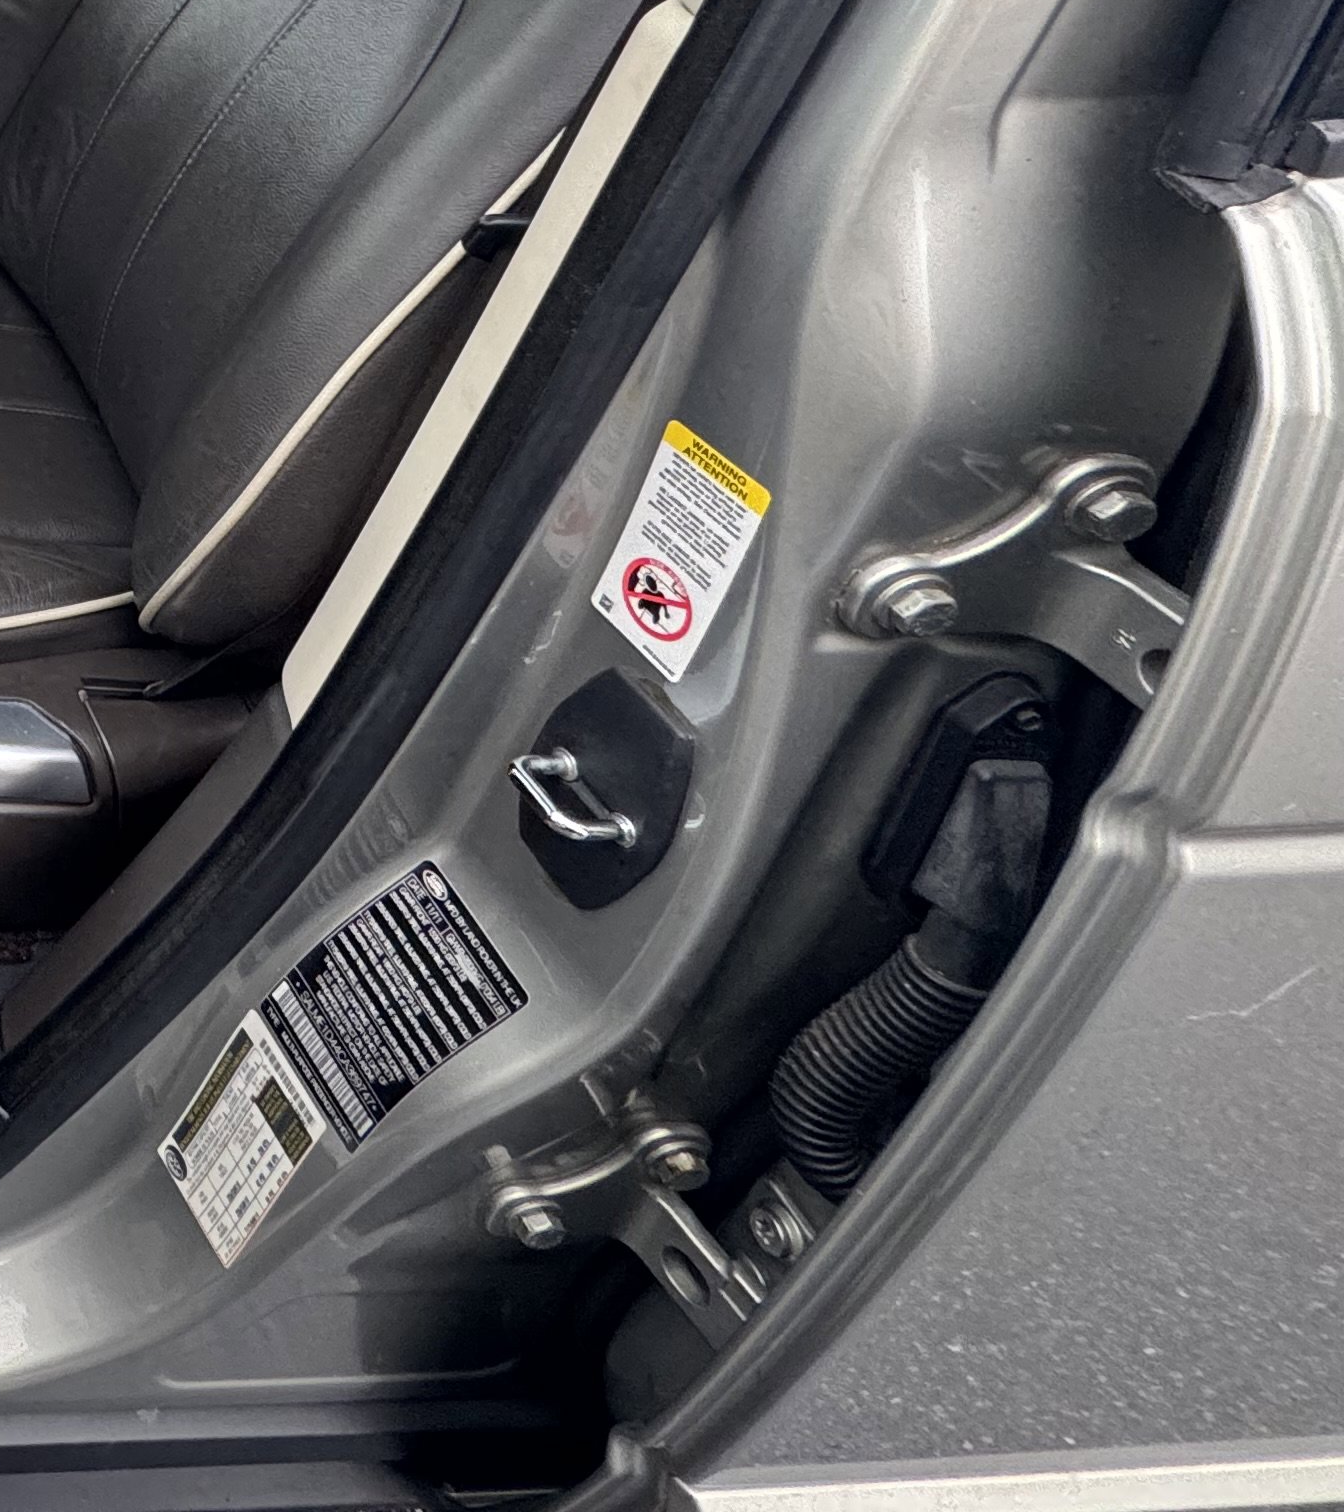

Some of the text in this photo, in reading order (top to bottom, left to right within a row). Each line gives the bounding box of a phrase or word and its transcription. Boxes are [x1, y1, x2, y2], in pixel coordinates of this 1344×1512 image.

[682, 446, 749, 502] ATTENTION
[691, 438, 748, 487] WARNING
[406, 877, 426, 902] DATE
[423, 901, 443, 925] 11/11
[461, 925, 481, 949] LAND
[474, 944, 499, 974] ROVER
